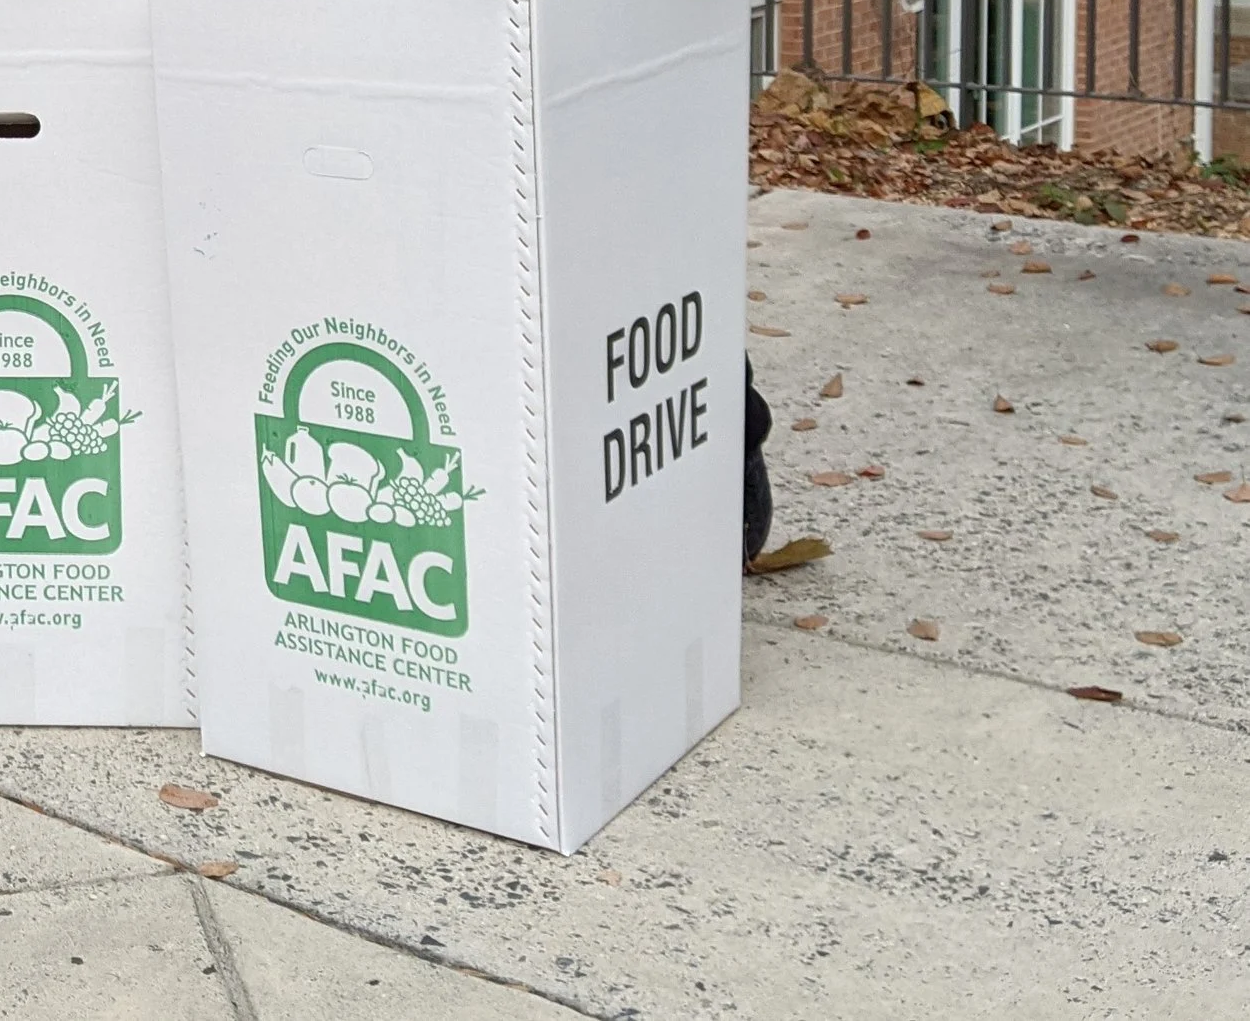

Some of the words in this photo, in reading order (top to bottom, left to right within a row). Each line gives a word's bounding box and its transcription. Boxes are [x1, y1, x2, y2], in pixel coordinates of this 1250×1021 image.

[74, 301, 92, 324] in
[86, 322, 114, 369] Need
[606, 290, 702, 404] FOOD
[259, 338, 296, 404] Feeding
[291, 322, 321, 346] Our
[324, 317, 417, 366] Neighbors
[412, 361, 431, 387] in
[427, 386, 456, 436] Need
[330, 381, 376, 403] Since
[334, 404, 376, 424] 1988
[603, 377, 708, 504] DRIVE
[43, 585, 124, 602] CENTER
[53, 564, 111, 580] FOOD
[273, 524, 457, 621] AFAC
[274, 630, 386, 672] ASSISTANCE
[393, 659, 473, 693] CENTER
[284, 611, 395, 652] ARLINGTON
[401, 637, 458, 665] FOOD
[314, 669, 431, 712] www.afac.org
